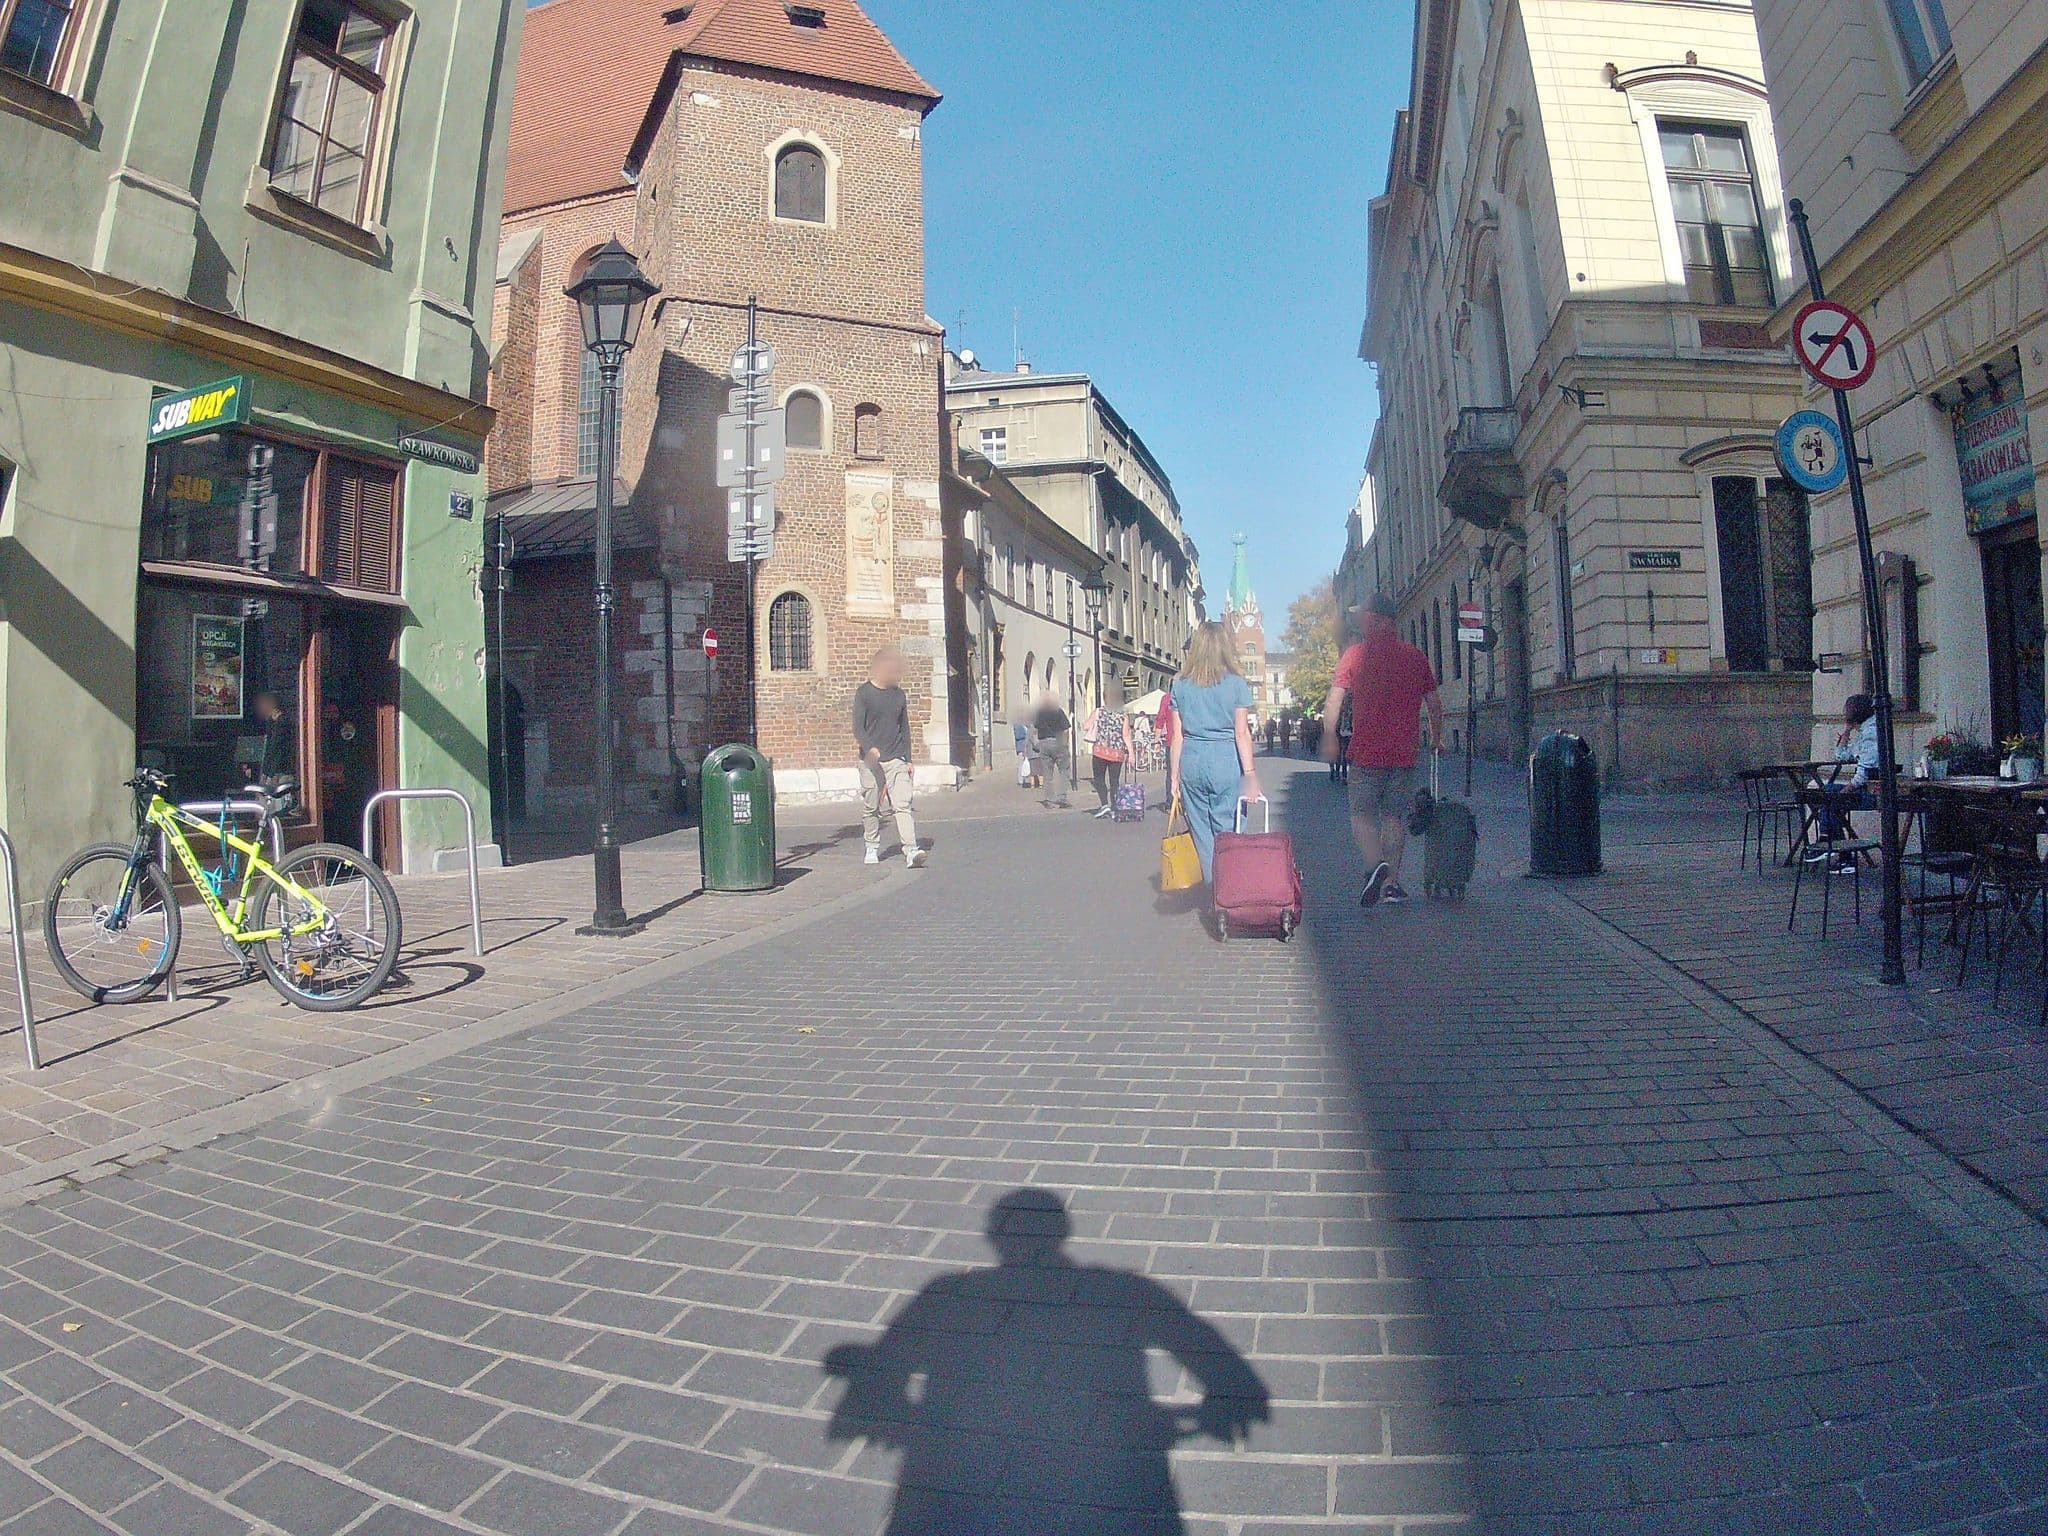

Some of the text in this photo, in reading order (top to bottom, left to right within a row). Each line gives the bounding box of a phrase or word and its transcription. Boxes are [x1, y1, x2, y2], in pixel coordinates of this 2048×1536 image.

[152, 384, 236, 435] SUBWAY
[405, 438, 476, 471] SŁAWKOWSKA
[1962, 434, 2032, 486] KRAKOWIACY
[457, 497, 469, 512] 22
